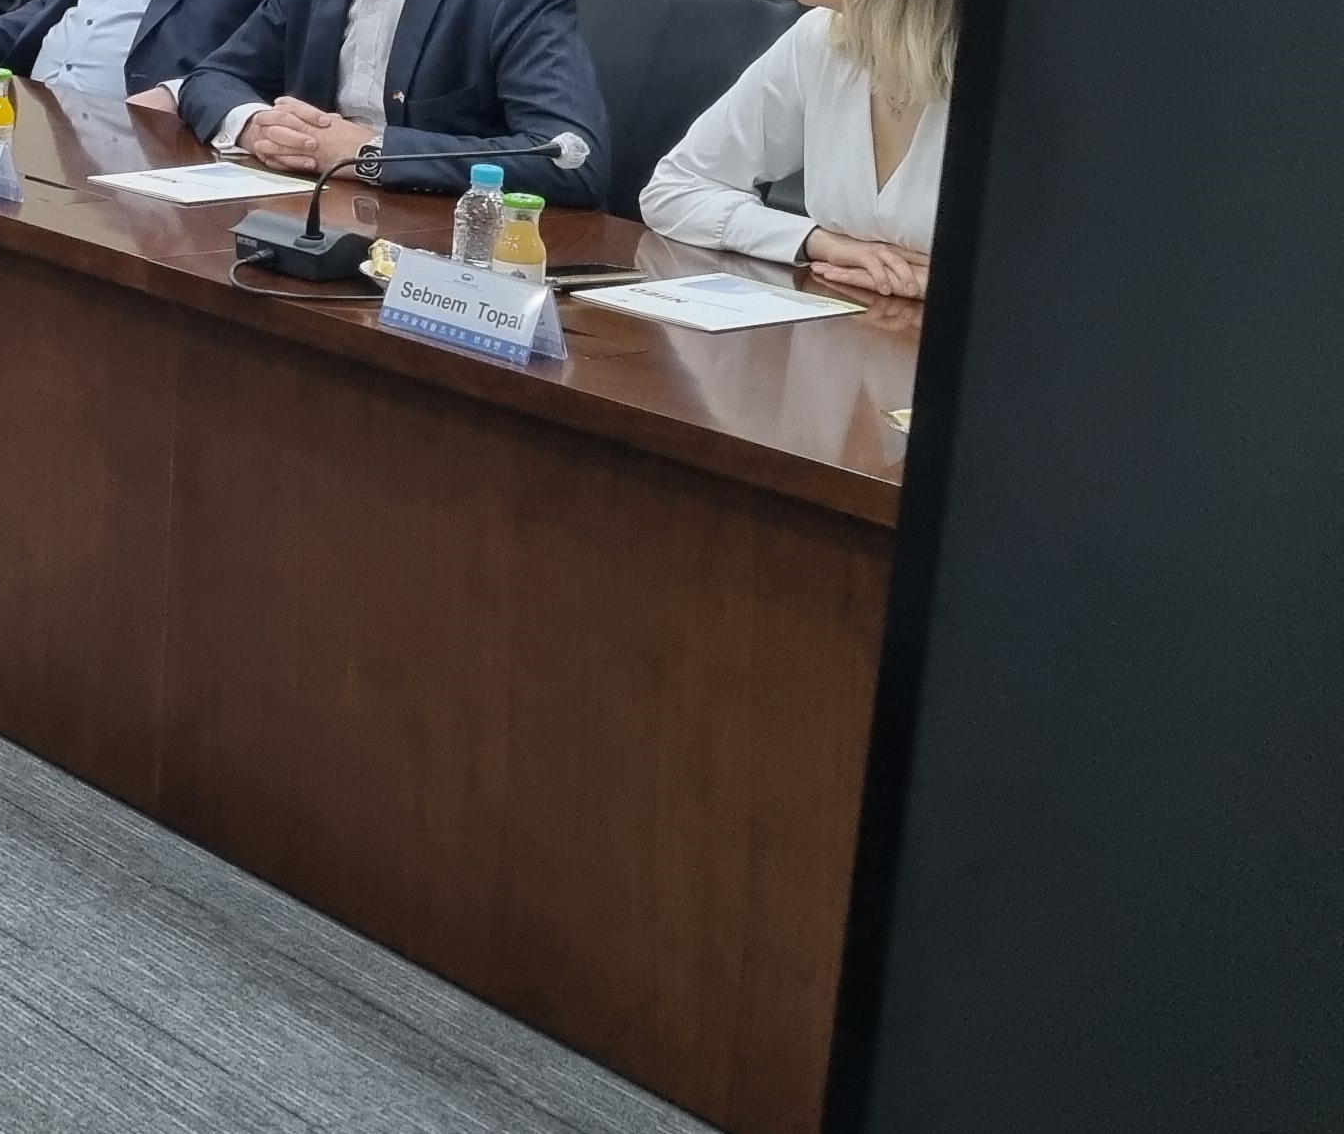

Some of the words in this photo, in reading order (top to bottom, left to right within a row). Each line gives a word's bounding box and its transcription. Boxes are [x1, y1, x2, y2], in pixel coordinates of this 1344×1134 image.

[400, 280, 468, 315] Sebnem
[478, 301, 526, 332] Topal
[628, 287, 690, 304] NIIED
